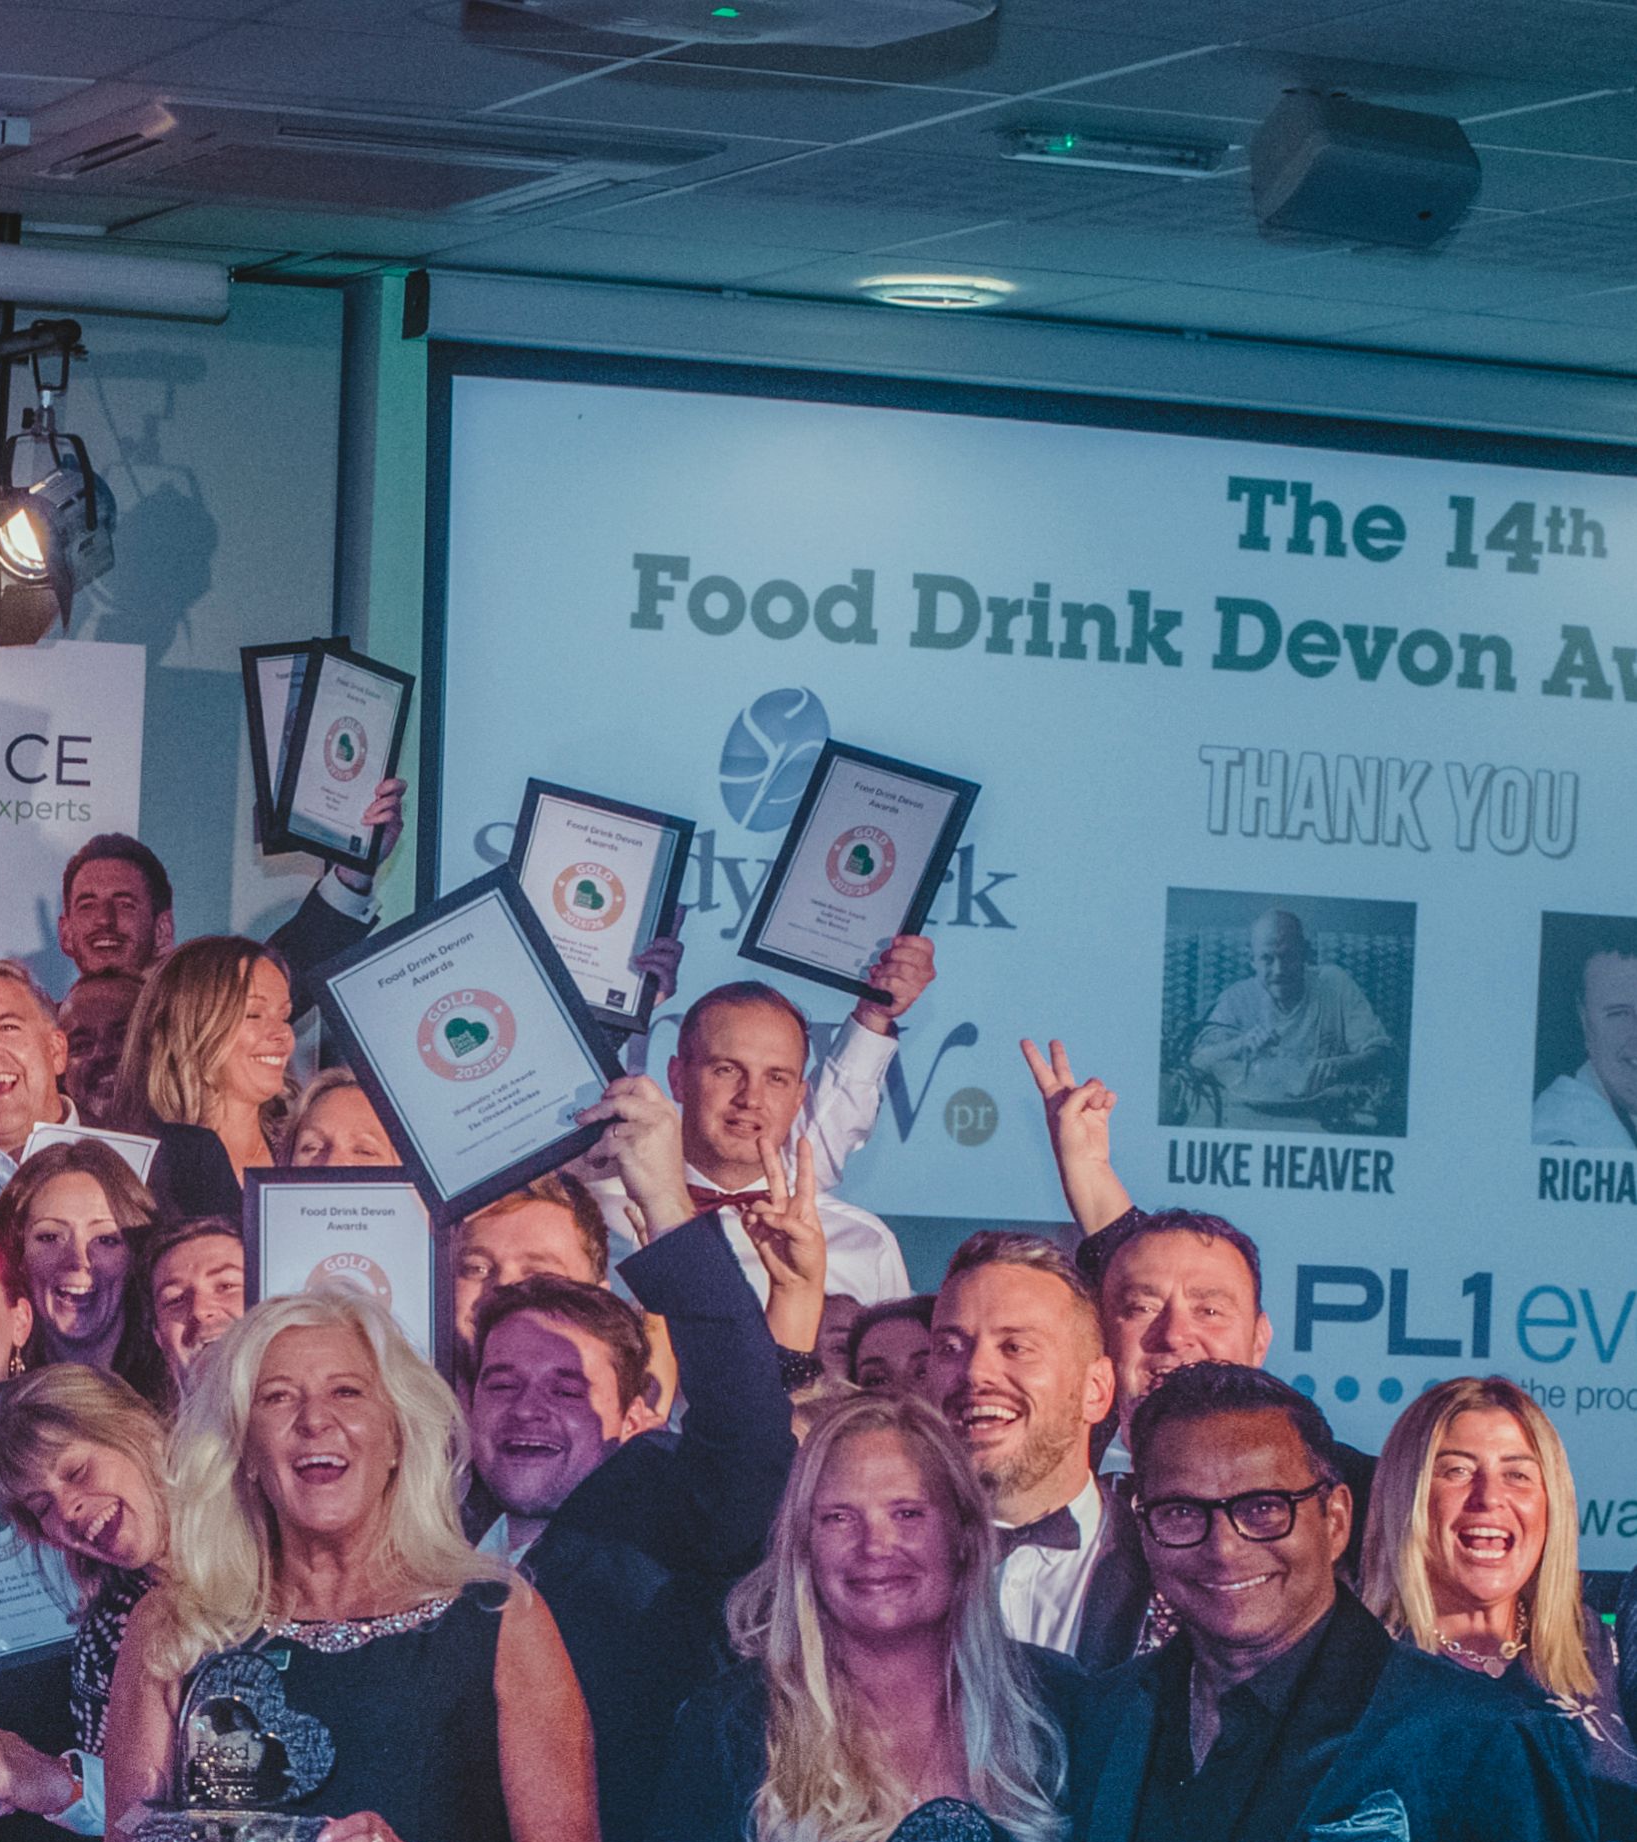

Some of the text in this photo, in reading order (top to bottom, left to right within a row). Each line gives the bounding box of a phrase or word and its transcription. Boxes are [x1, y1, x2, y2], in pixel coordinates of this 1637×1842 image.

[1227, 475, 1607, 575] The 14th
[630, 552, 878, 645] Food
[909, 572, 1183, 667] Drink
[1211, 595, 1516, 693] Devon
[1199, 744, 1580, 859] THANK YOU
[376, 931, 474, 989] Food Drink Devon
[411, 959, 454, 987] Awards
[953, 1104, 991, 1137] pr
[1168, 1139, 1395, 1194] LUKE HEAVER
[1538, 1157, 1637, 1205] RICHA
[1293, 1263, 1493, 1358] PL1
